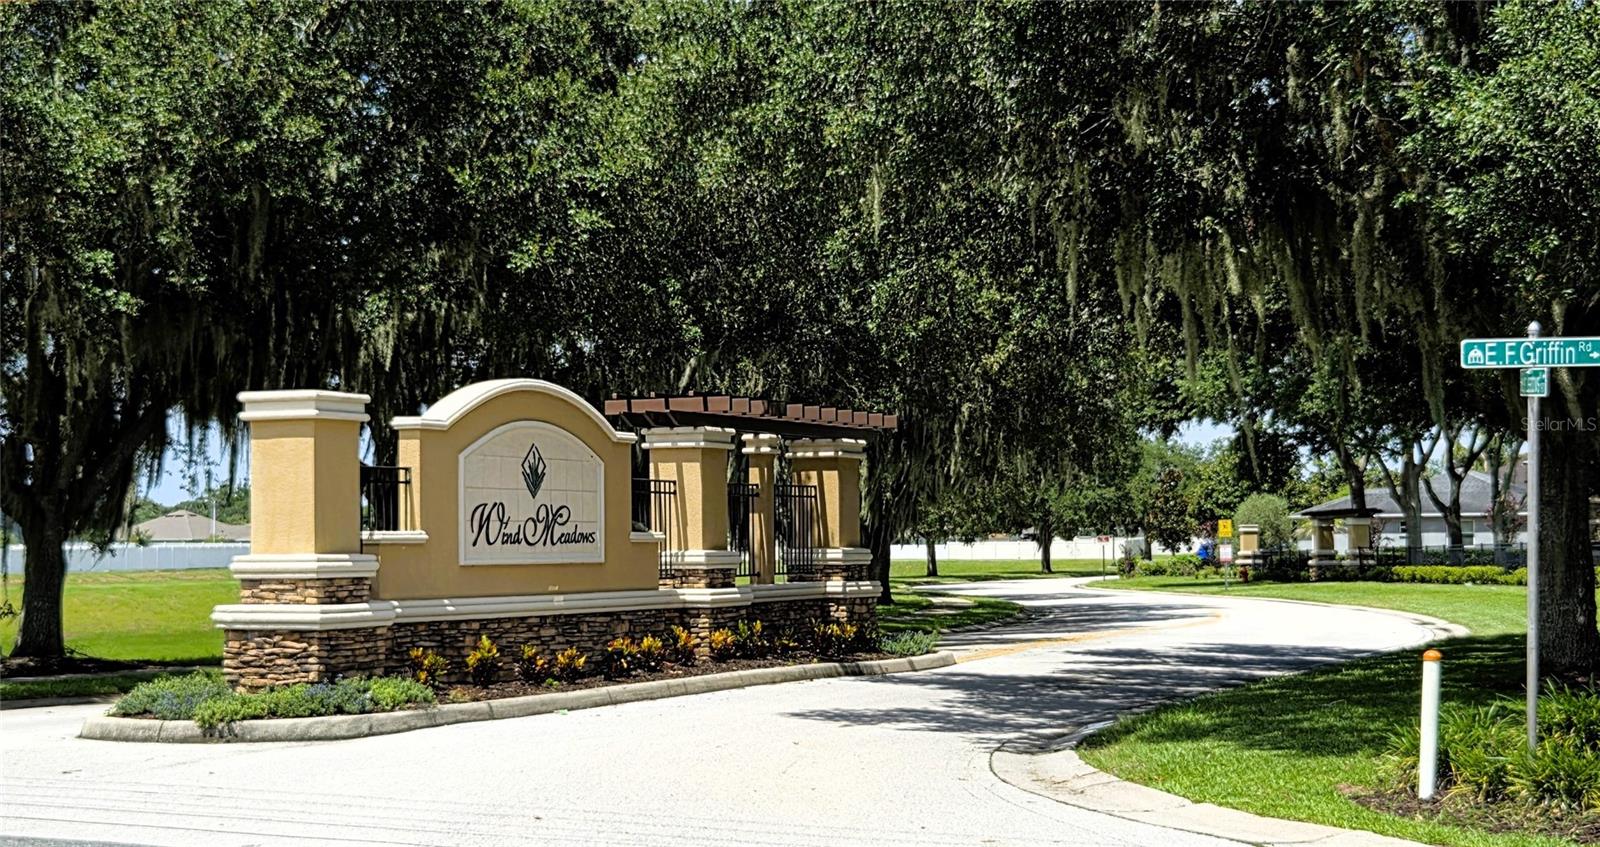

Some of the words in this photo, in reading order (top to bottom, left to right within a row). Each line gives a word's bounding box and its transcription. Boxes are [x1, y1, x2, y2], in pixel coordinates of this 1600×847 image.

[1578, 341, 1593, 352] Rd
[470, 502, 523, 547] Wind
[523, 503, 597, 547] Meadows
